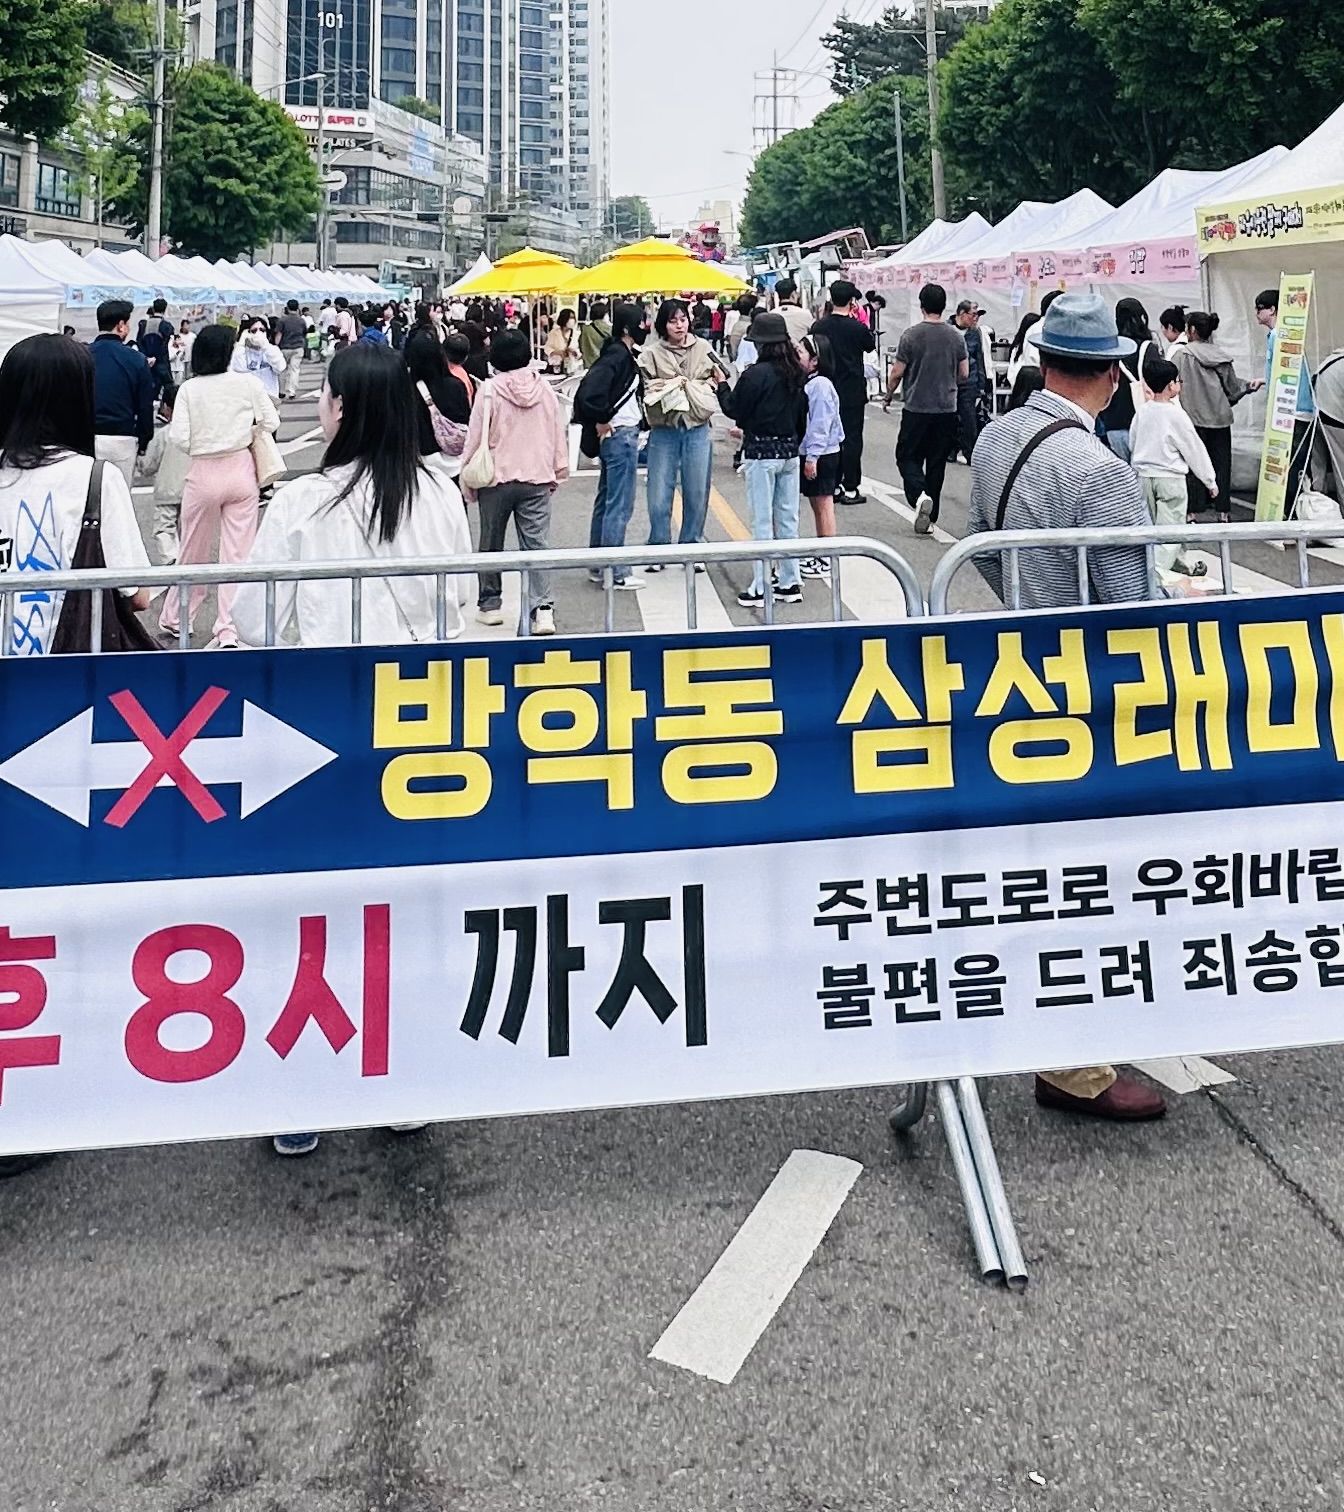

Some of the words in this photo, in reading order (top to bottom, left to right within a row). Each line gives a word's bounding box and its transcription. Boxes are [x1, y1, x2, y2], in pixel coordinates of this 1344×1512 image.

[316, 10, 344, 30] 101
[295, 114, 323, 123] LOTT
[327, 115, 355, 125] SUPER
[372, 644, 784, 822] 방학동
[812, 862, 1115, 941] 주변도로로
[122, 902, 391, 1084] 8시
[458, 883, 709, 1058] 까지
[816, 952, 1009, 1031] 불편을
[1035, 938, 1155, 1009] 드려
